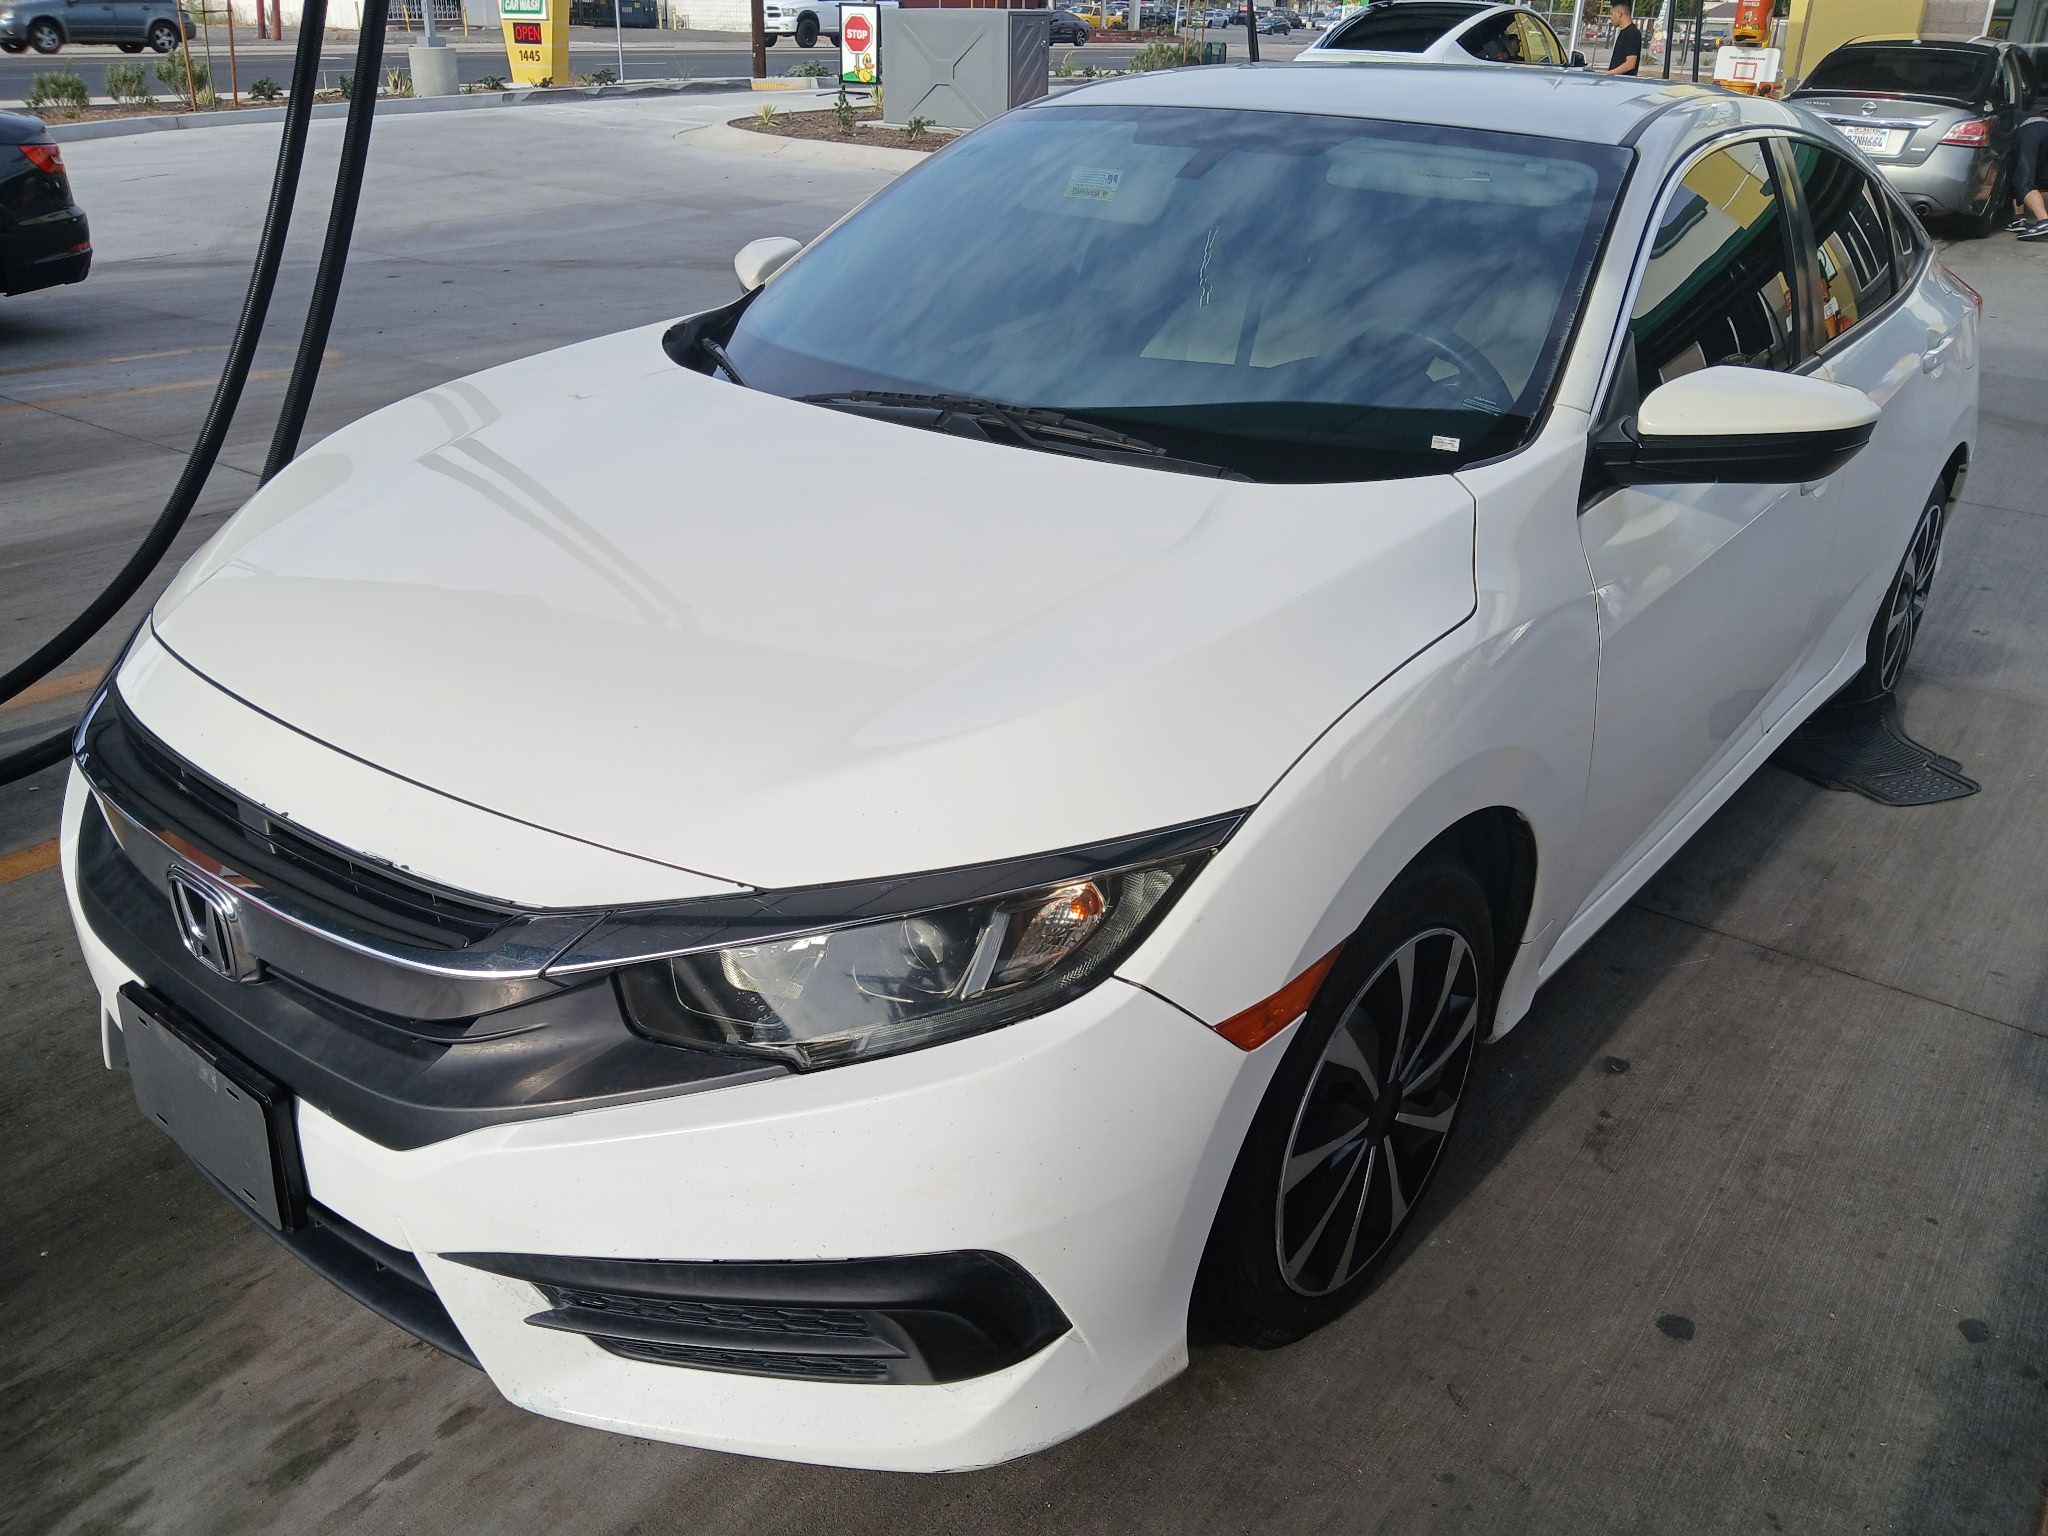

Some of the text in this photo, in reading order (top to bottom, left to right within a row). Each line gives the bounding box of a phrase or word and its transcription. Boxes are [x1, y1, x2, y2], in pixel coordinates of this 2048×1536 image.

[505, 0, 539, 11] CAR WASH
[516, 26, 541, 41] OPEN
[847, 29, 868, 39] STOP
[519, 50, 541, 62] 1445
